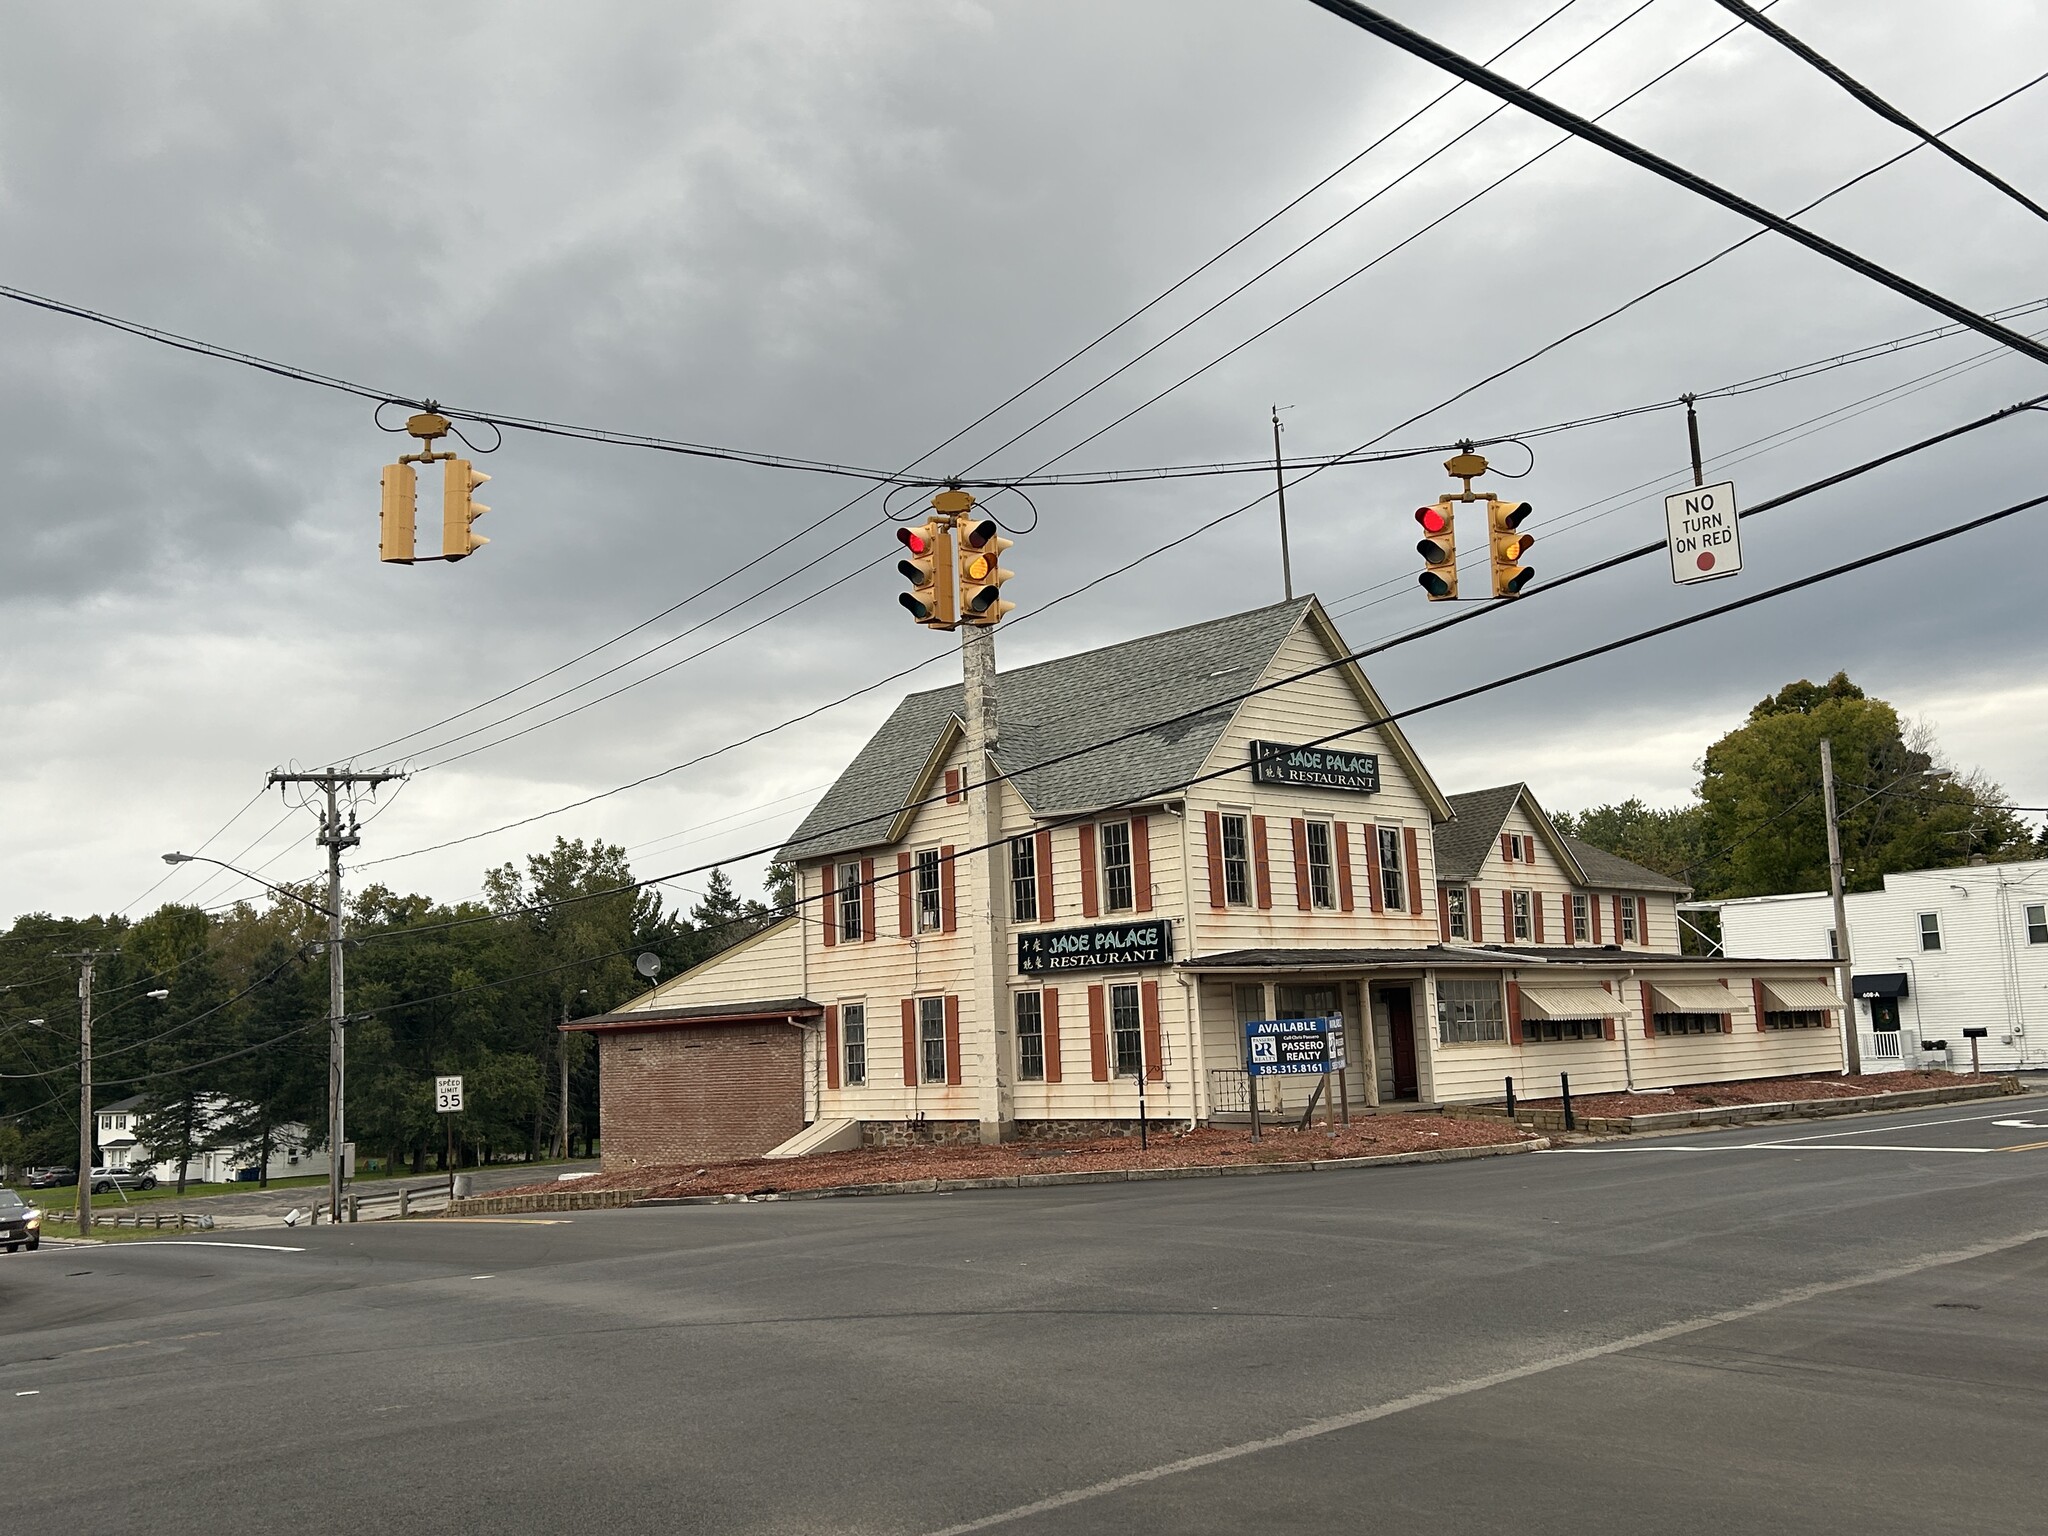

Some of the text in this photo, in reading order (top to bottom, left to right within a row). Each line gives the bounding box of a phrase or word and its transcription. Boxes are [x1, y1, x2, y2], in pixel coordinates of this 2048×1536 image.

[1685, 494, 1714, 515] NO
[1682, 513, 1722, 533] TURN
[1676, 529, 1732, 553] ON RED
[1288, 750, 1374, 774] JADE PALACE
[1289, 769, 1375, 788] RESTAURANT
[1048, 927, 1159, 954] JADE PALACE
[1050, 949, 1159, 968] RESTAURANT
[1258, 1022, 1316, 1033] AVAILABLE
[1255, 1042, 1275, 1056] PR
[1281, 1041, 1324, 1051] PASSERO
[1286, 1051, 1321, 1061] REALTY
[1260, 1063, 1323, 1075] 585.315.8161
[439, 1094, 461, 1108] 35
